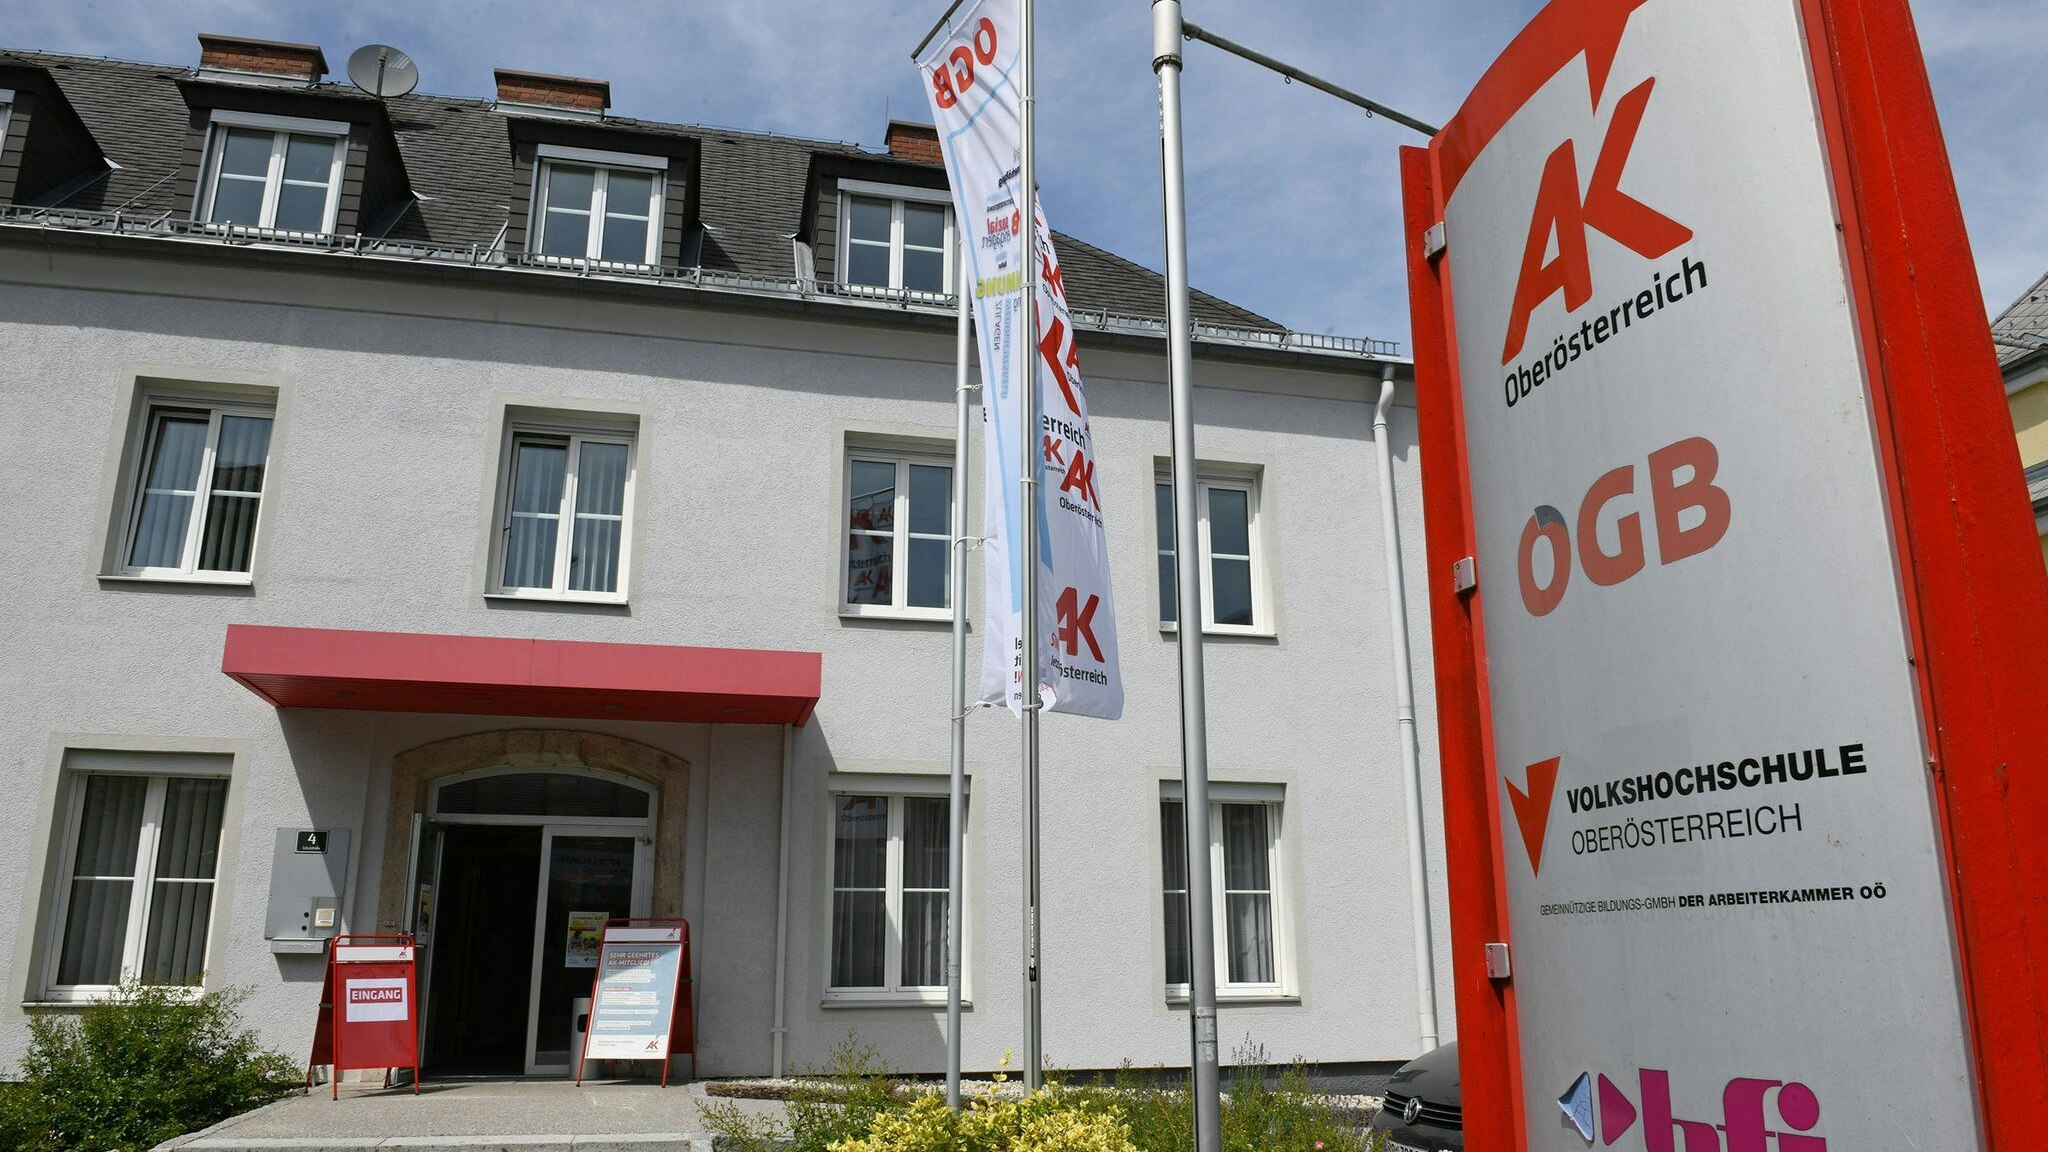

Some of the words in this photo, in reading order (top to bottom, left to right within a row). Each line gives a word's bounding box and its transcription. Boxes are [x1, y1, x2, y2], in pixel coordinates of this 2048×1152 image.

[1502, 76, 1694, 366] AK
[1504, 256, 1708, 407] Oberösterreich
[1060, 450, 1101, 513] AK
[1056, 586, 1106, 664] AK
[1566, 743, 1867, 814] VOLKSHOCHSCHULE
[307, 833, 317, 845] 4
[1572, 802, 1803, 855] OBERÖSTERREICH
[1540, 898, 1596, 916] GEMEINNÜTZIGE
[1598, 896, 1677, 913] BILDUNGS-GMBH
[1678, 894, 1705, 908] DER
[1708, 886, 1855, 907] ARBEITERKAMMER
[1860, 882, 1887, 900] OÖ
[351, 989, 402, 1001] EINGANG
[646, 1040, 660, 1050] AK
